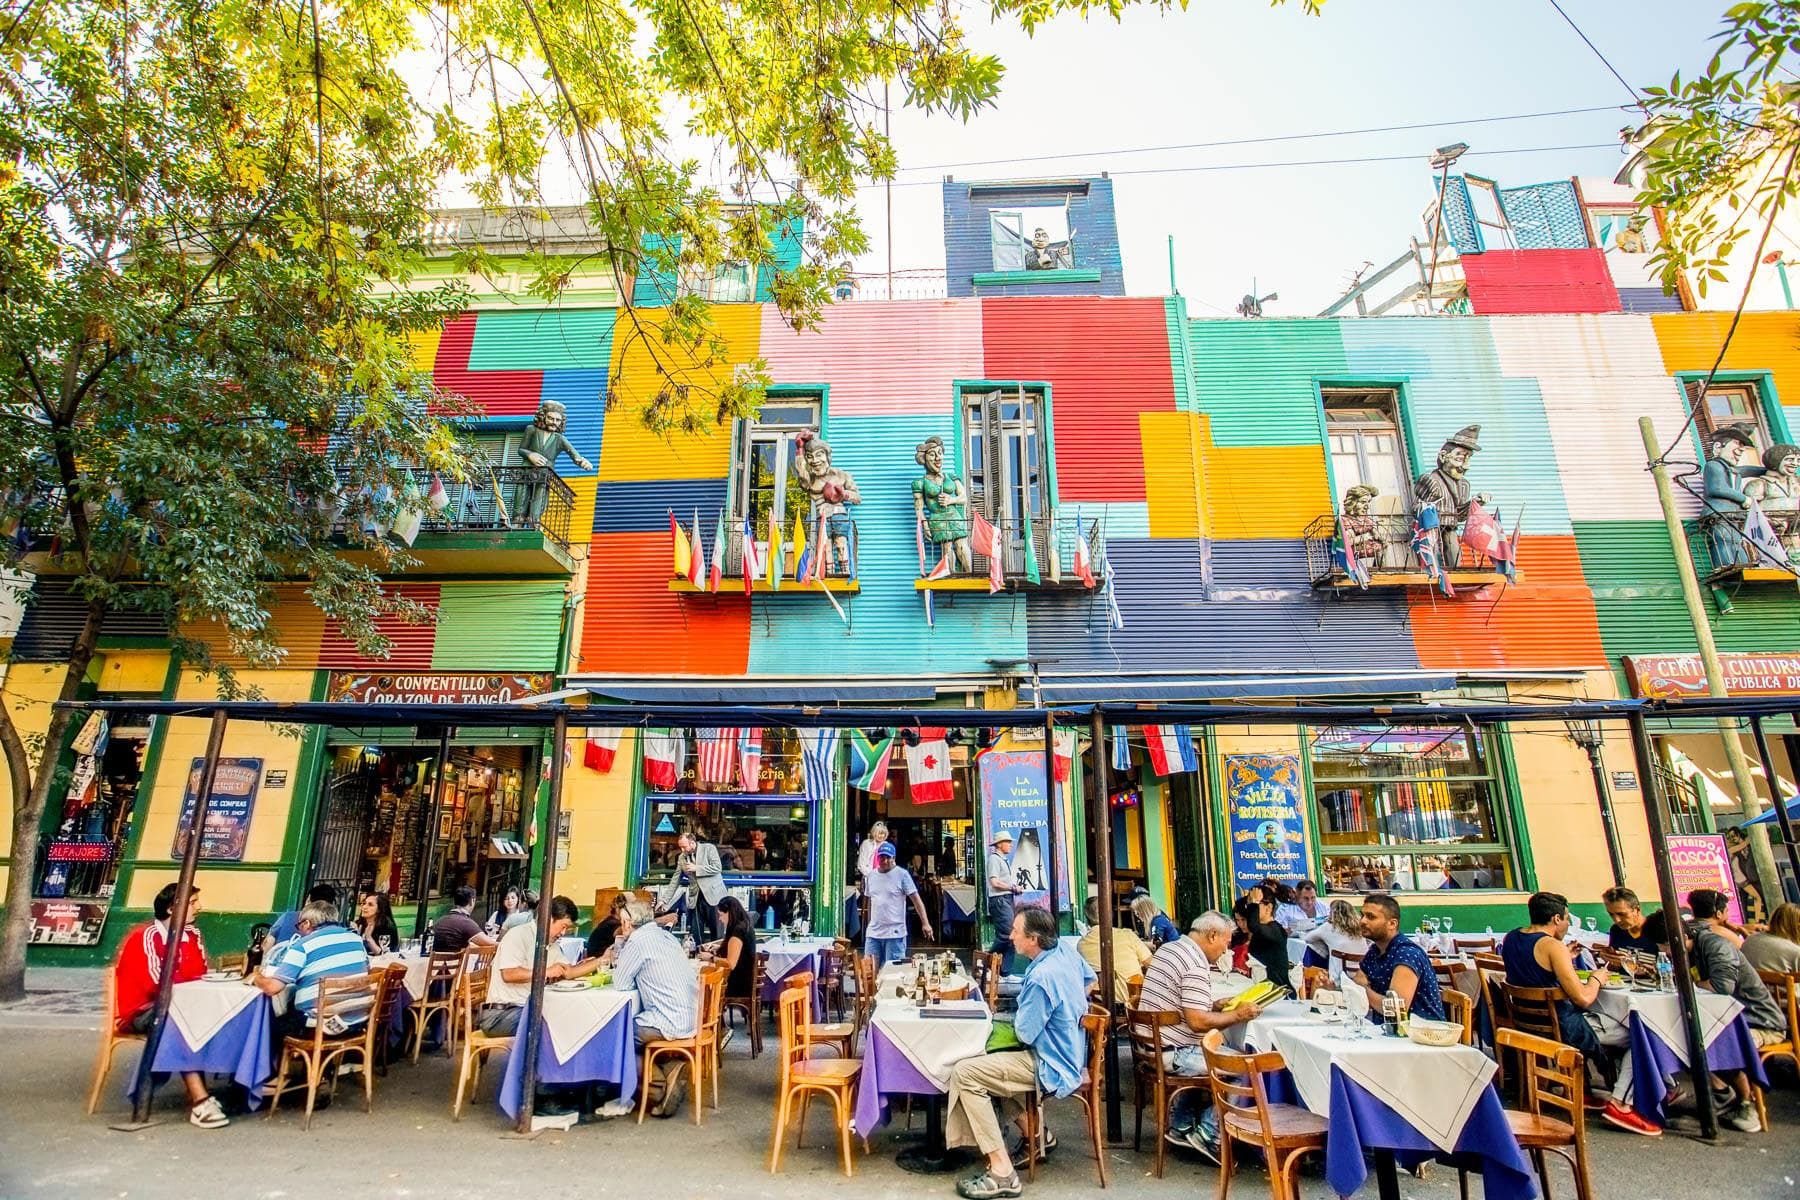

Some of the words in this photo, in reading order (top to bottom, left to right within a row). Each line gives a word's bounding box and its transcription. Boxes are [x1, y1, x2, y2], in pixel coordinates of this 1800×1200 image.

[1657, 659, 1724, 677] CENT
[395, 676, 486, 691] CONVENTILLO
[1725, 676, 1781, 689] EPUBLICA
[364, 686, 434, 704] CORAZON
[438, 693, 456, 704] DE
[461, 687, 511, 704] TANGO
[1016, 776, 1030, 785] LA
[1261, 781, 1271, 790] LA
[1010, 787, 1039, 796] VIEJA
[1244, 789, 1287, 804] VIEJA
[1238, 805, 1297, 819] ROTISERIA
[1000, 820, 1030, 828] RESTO
[1036, 820, 1048, 828] BA
[51, 847, 107, 857] ALFAJORES
[1240, 850, 1267, 859] Pastas
[1271, 850, 1300, 859] Caseras
[1255, 862, 1291, 870] Mariscos
[1237, 871, 1264, 880] Carnes
[1266, 872, 1306, 881] Argentinas
